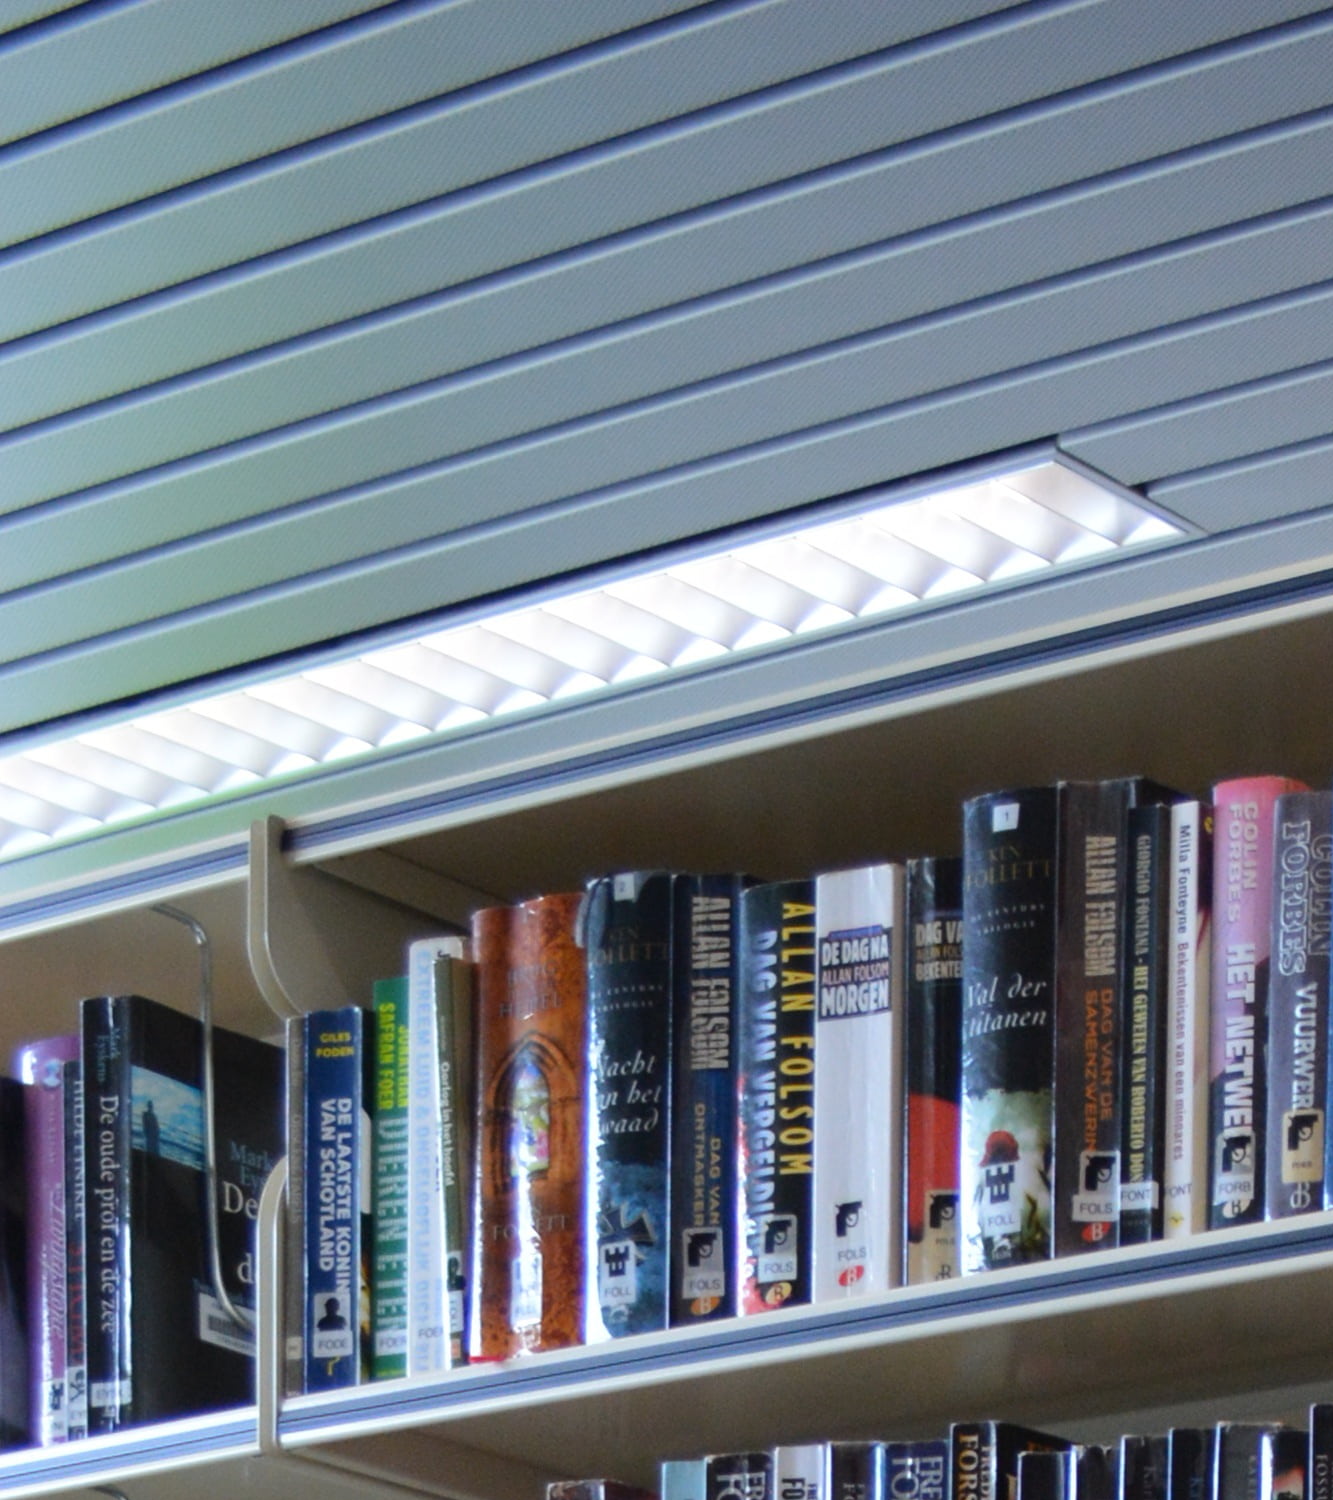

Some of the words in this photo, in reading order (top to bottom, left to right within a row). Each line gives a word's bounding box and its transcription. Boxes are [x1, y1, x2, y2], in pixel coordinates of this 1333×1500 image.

[1228, 803, 1243, 924] FORBES
[1243, 801, 1258, 890] COLIN
[782, 902, 816, 1012] ALLAN
[821, 943, 839, 965] DE
[840, 937, 868, 962] DAG
[869, 934, 890, 957] NA
[821, 967, 852, 983] ALLAN
[854, 961, 890, 980] FOLSOM
[1227, 943, 1255, 1002] HET
[820, 981, 890, 1016] MORGEN
[316, 1047, 354, 1058] FODEN
[320, 1032, 351, 1044] GILES
[378, 1002, 395, 1066] SAFRAN
[100, 1096, 119, 1123] De
[378, 1070, 393, 1110] FOER
[779, 1035, 815, 1175] FOLSOM
[322, 1099, 336, 1139] VAN
[340, 1098, 352, 1123] DE
[100, 1128, 118, 1178] oude
[339, 1128, 352, 1216] LAATSTE
[95, 1185, 118, 1233] prof
[319, 1147, 336, 1271] SCHOTLAND
[100, 1239, 115, 1263] en
[100, 1268, 118, 1291] de
